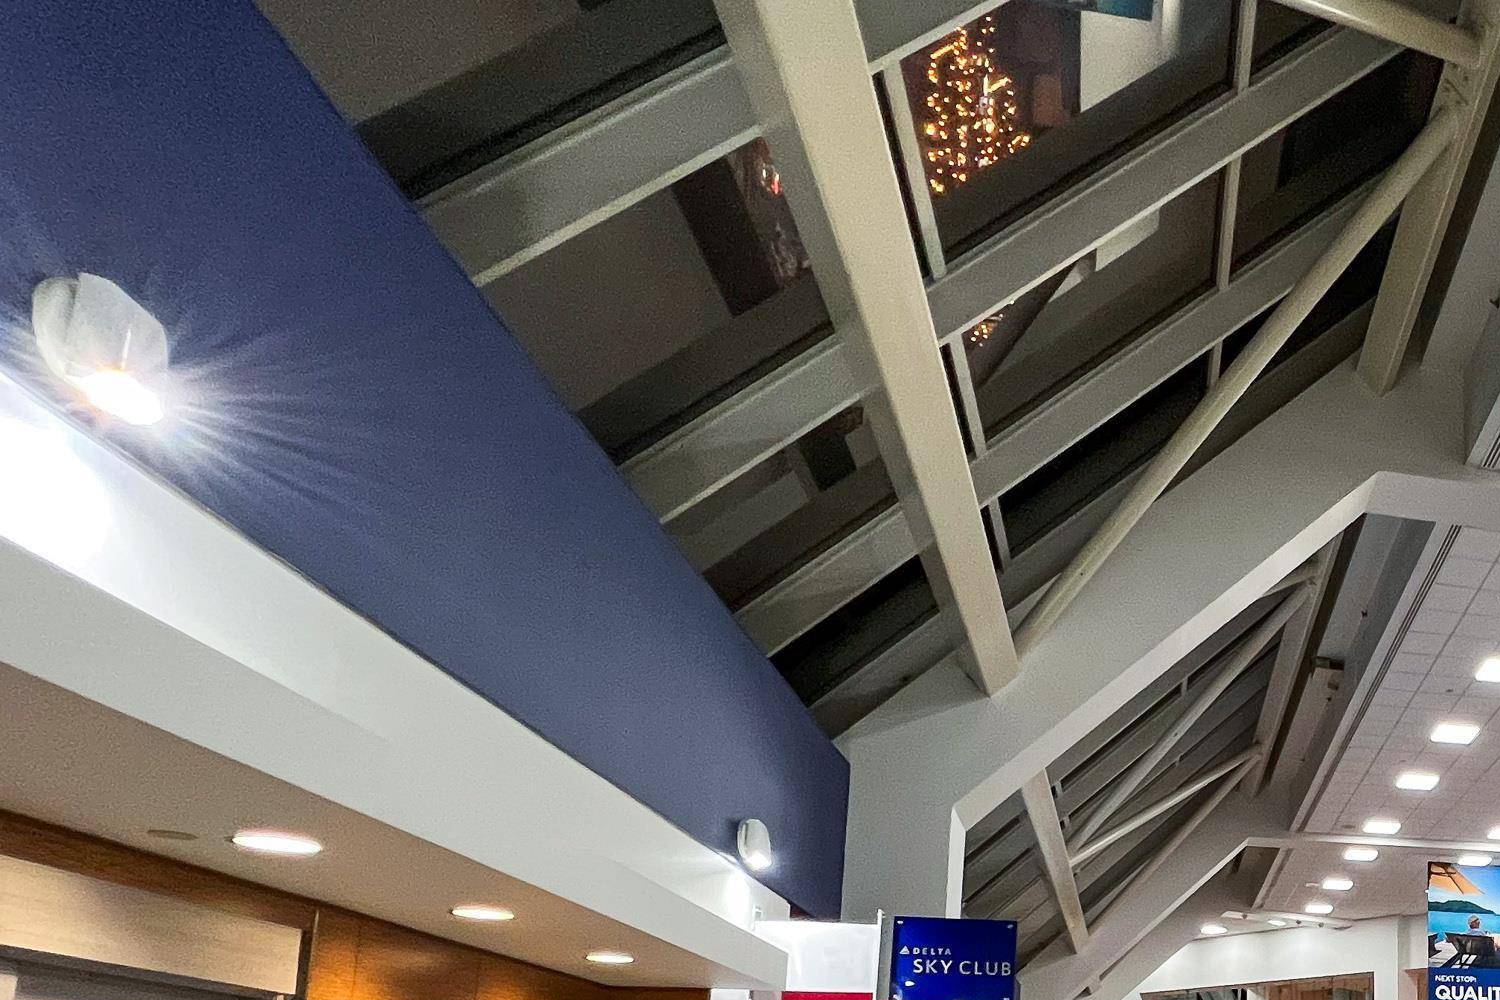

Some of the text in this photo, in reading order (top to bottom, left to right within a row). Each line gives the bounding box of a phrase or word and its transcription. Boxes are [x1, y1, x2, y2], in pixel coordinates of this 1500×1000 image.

[912, 947, 952, 956] DELTA
[912, 959, 1012, 977] SKY CLUB
[1435, 974, 1454, 982] NEXT
